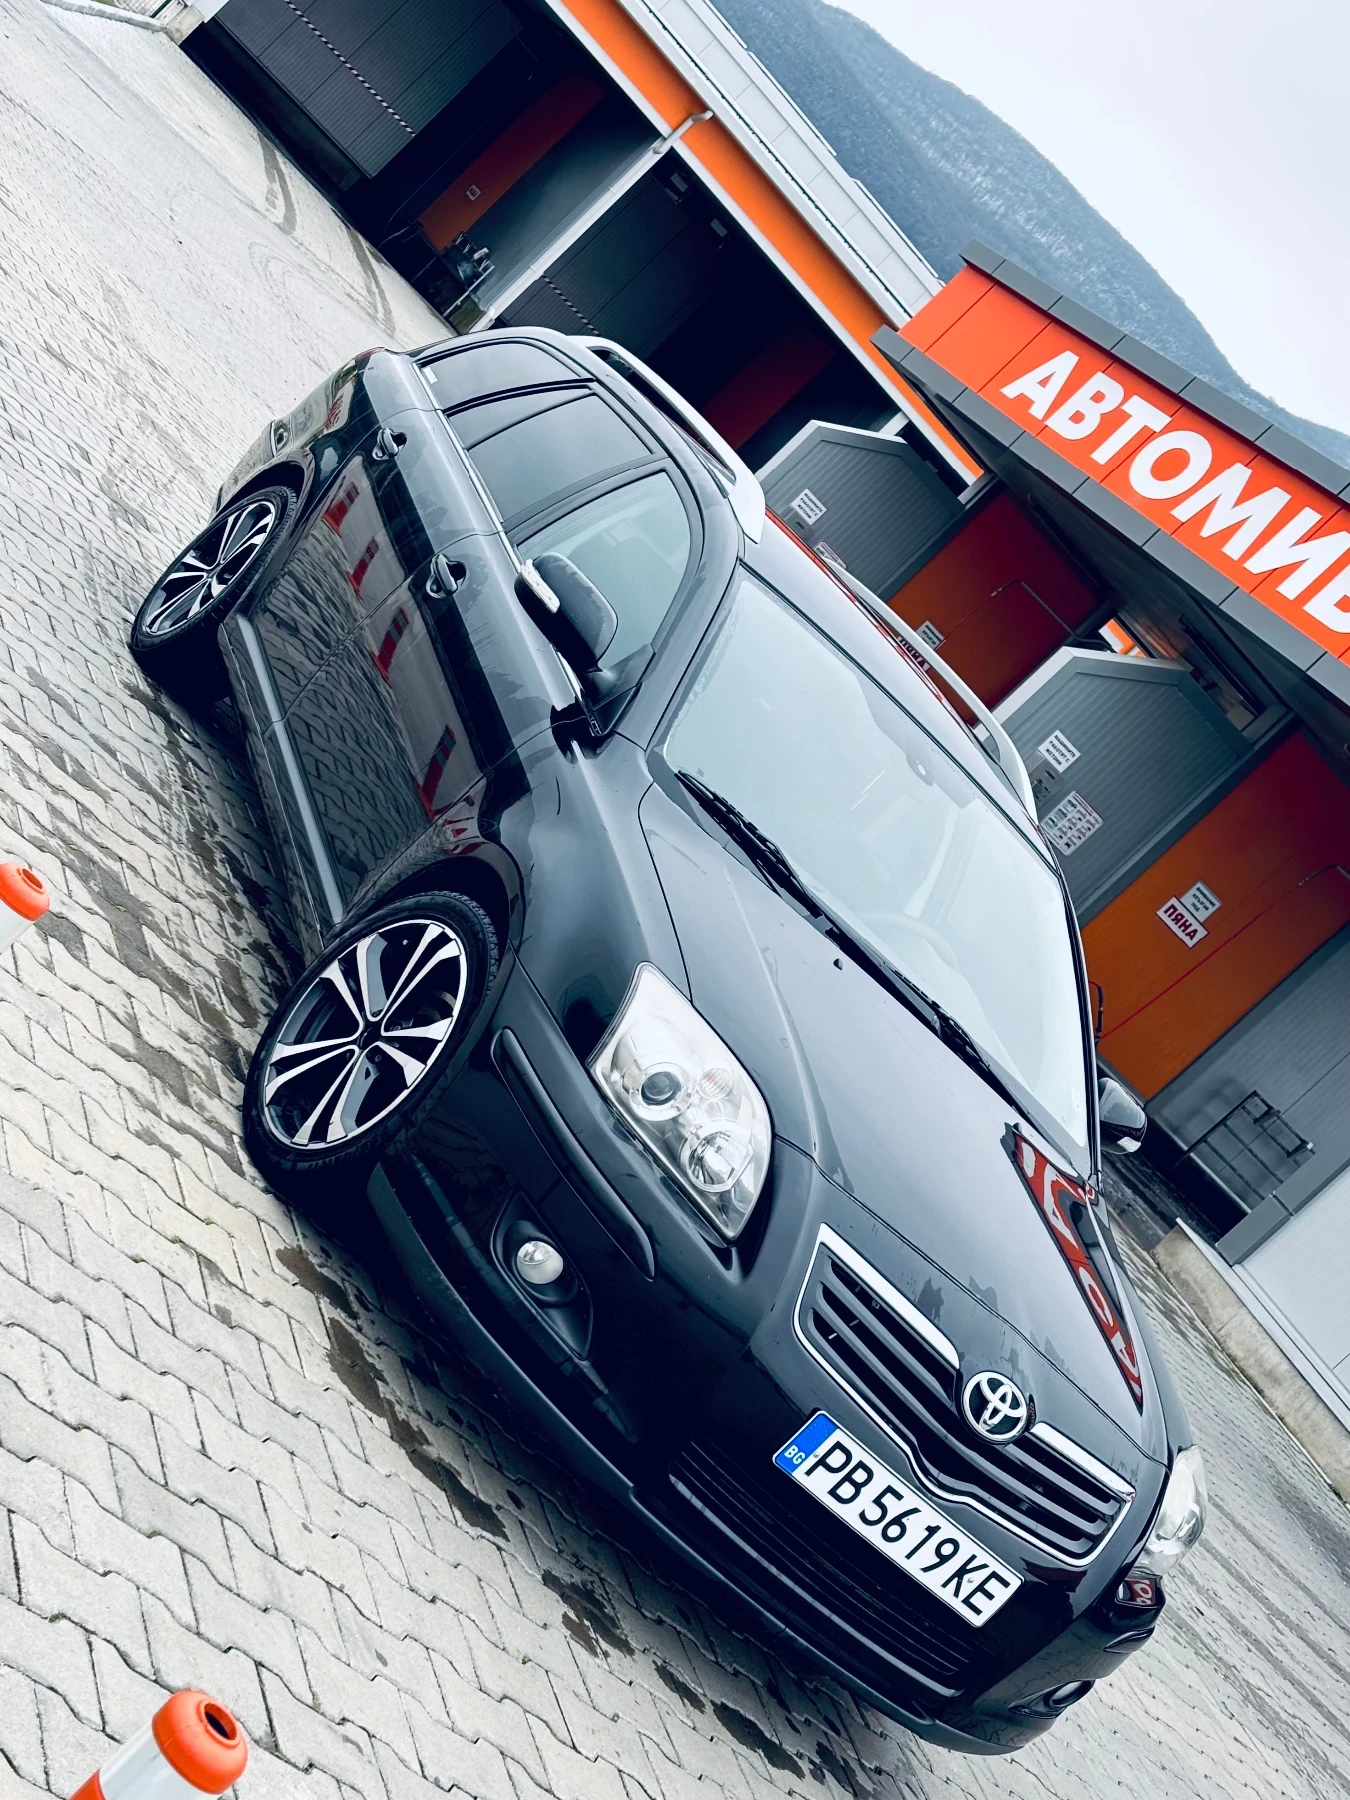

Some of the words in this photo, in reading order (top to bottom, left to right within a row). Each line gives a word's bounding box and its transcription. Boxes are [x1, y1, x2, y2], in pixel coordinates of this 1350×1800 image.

[1045, 748, 1062, 765] ЖЕТОНИ
[1049, 740, 1067, 759] РАБОТЯТ
[1054, 735, 1076, 758] МАШИНИТЕ
[1163, 903, 1198, 941] ПЯНА
[784, 1445, 806, 1465] BG
[805, 1440, 874, 1505] PB
[858, 1484, 960, 1573] 5619
[940, 1553, 1012, 1617] KE
